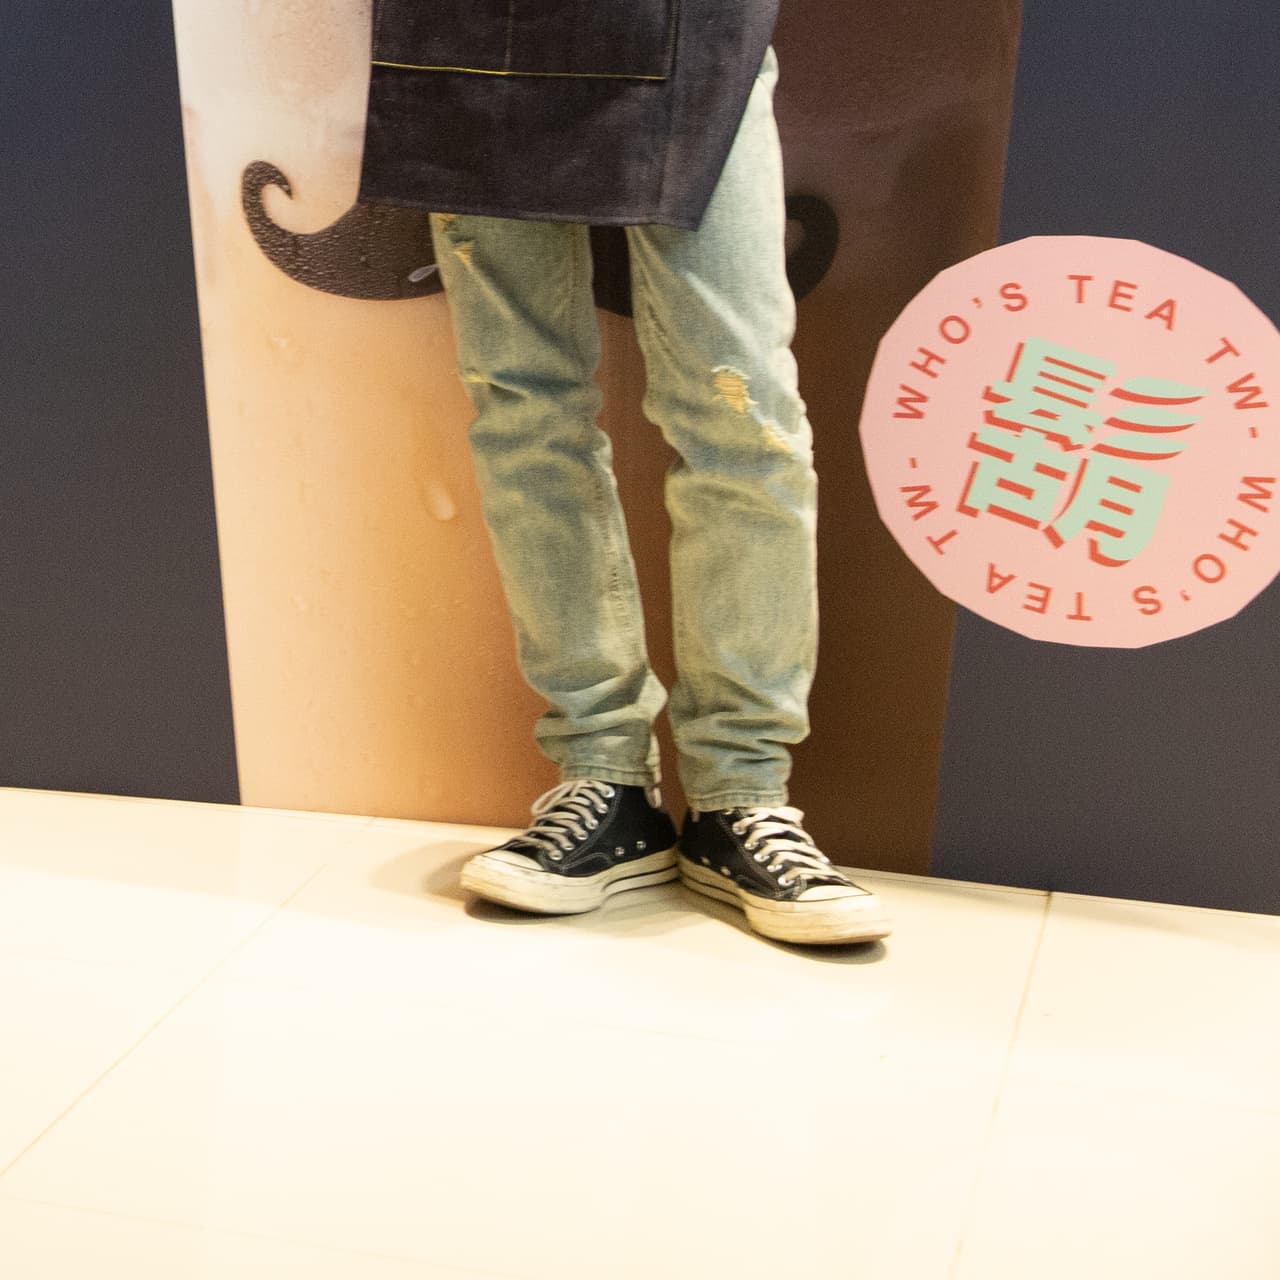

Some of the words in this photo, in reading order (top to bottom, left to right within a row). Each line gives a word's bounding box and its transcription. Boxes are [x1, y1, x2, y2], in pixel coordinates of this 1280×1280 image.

[892, 281, 1030, 420] WHO'S
[1066, 273, 1180, 331] TEA
[955, 335, 1213, 568] 鬍
[985, 562, 1094, 621] TEA
